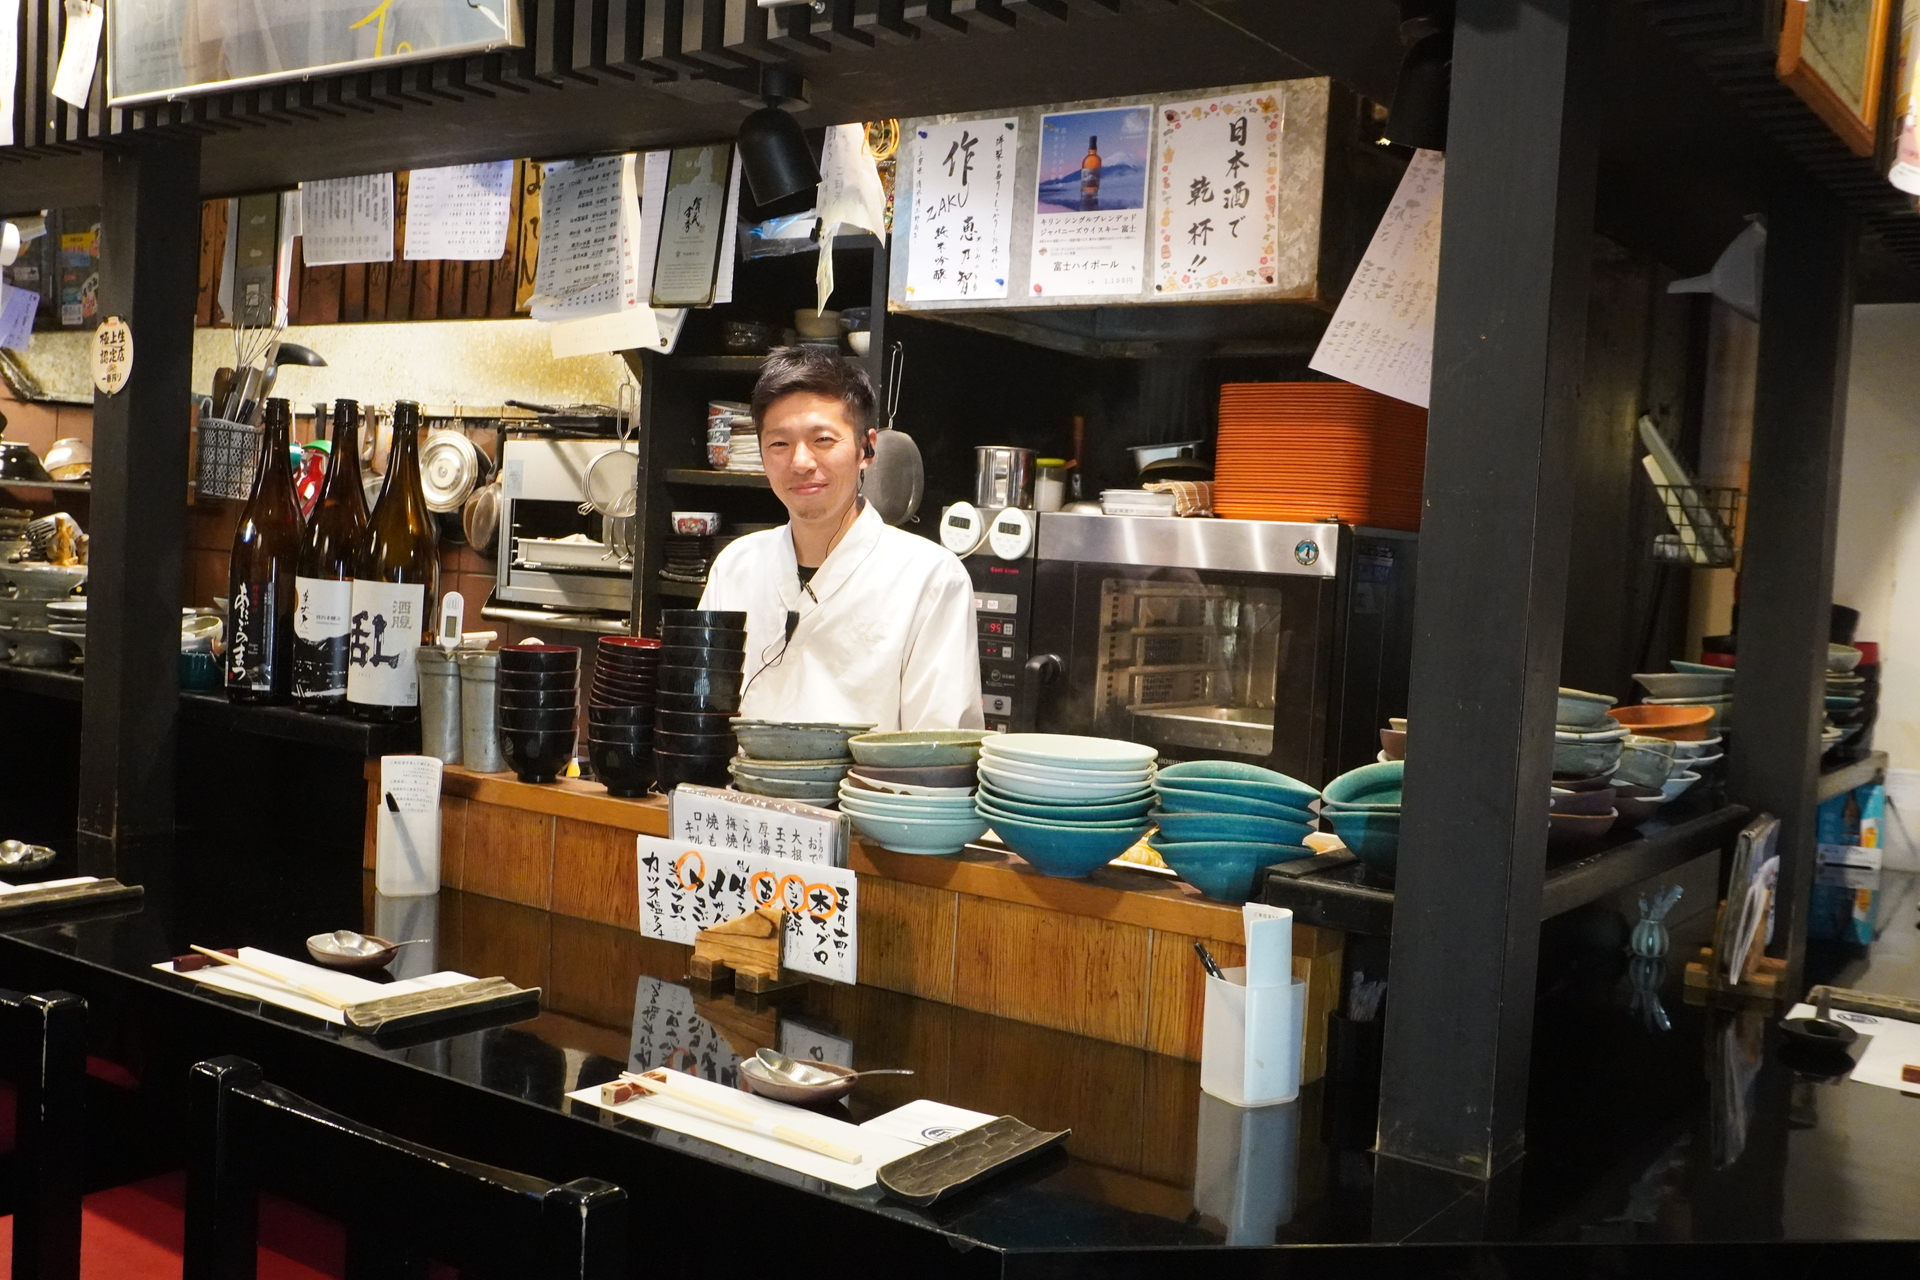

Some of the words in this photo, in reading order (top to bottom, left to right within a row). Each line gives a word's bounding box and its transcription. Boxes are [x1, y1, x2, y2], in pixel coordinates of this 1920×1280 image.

[942, 130, 979, 187] 作
[1223, 116, 1250, 238] 日本酒で
[926, 182, 971, 223] ZAKU
[1041, 218, 1061, 226] キリン
[1064, 213, 1137, 225] シングルブレンデッド
[1040, 226, 1119, 236] ジャパニーズウイスキー
[1121, 224, 1137, 233] 富士
[933, 225, 949, 284] 純米吟醸
[957, 216, 977, 295] 恵乃智
[1053, 260, 1119, 272] 富士ハイボール
[99, 329, 126, 346] 極上生
[99, 346, 126, 364] 認定店
[350, 610, 401, 670] 乱
[758, 822, 771, 856] 厚揚
[775, 827, 787, 858] 玉子
[791, 829, 803, 862] 大根
[809, 889, 831, 965] 本マグロ
